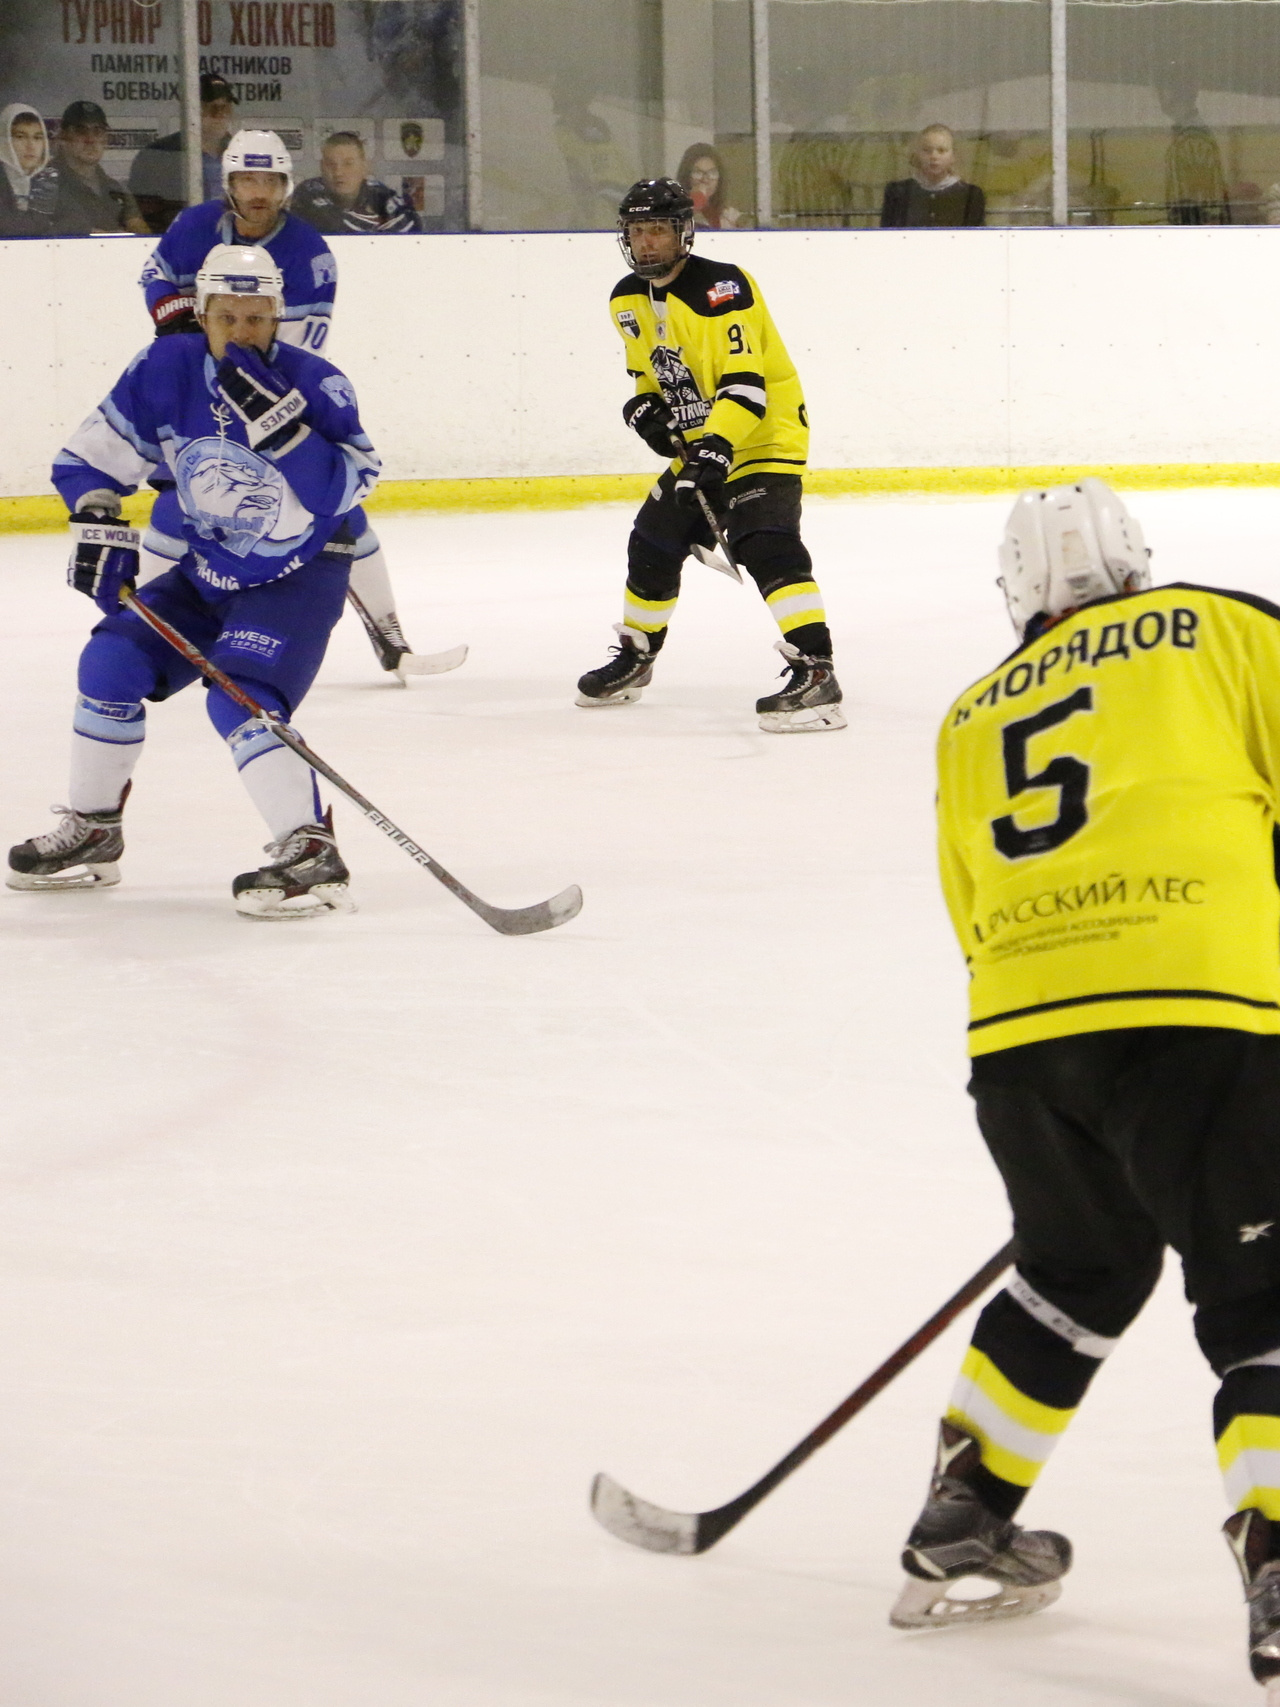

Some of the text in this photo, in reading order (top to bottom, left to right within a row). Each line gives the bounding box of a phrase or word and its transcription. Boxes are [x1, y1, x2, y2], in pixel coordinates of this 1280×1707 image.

[61, 0, 162, 44] ТУРНИР
[229, 2, 336, 47] ХОККЕЮ
[91, 54, 168, 74] ПАМЯТИ
[103, 81, 180, 101] БОЕВЫХ
[301, 321, 328, 350] 10
[260, 395, 302, 431] WOLVES
[699, 450, 730, 467] EAST
[82, 528, 101, 540] ICE
[230, 640, 275, 656] СЕРВИС
[991, 686, 1094, 861] 5
[1138, 877, 1205, 905] ЛЕС
